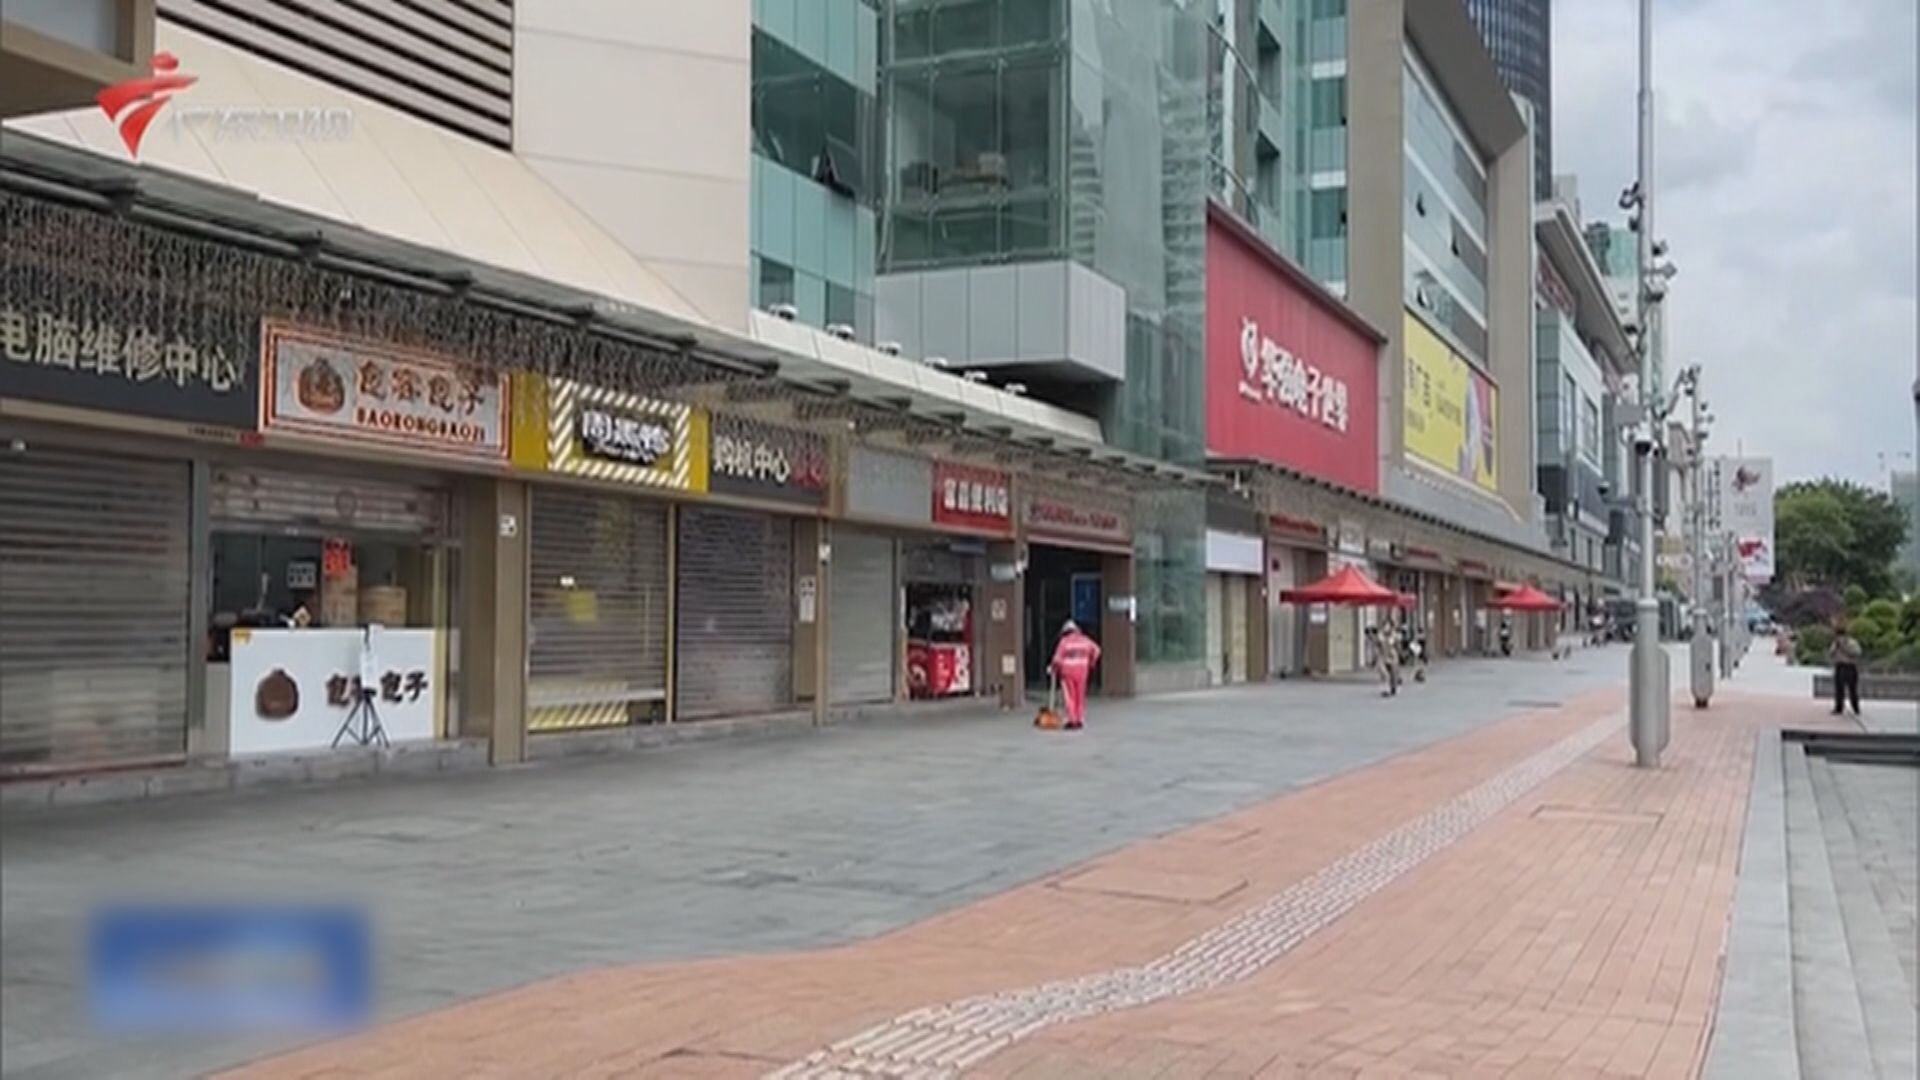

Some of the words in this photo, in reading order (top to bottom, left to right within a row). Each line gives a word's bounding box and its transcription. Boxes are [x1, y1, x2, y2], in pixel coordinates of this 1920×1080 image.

[0, 307, 238, 392] 电脑维修中心
[325, 669, 429, 709] 包包子
